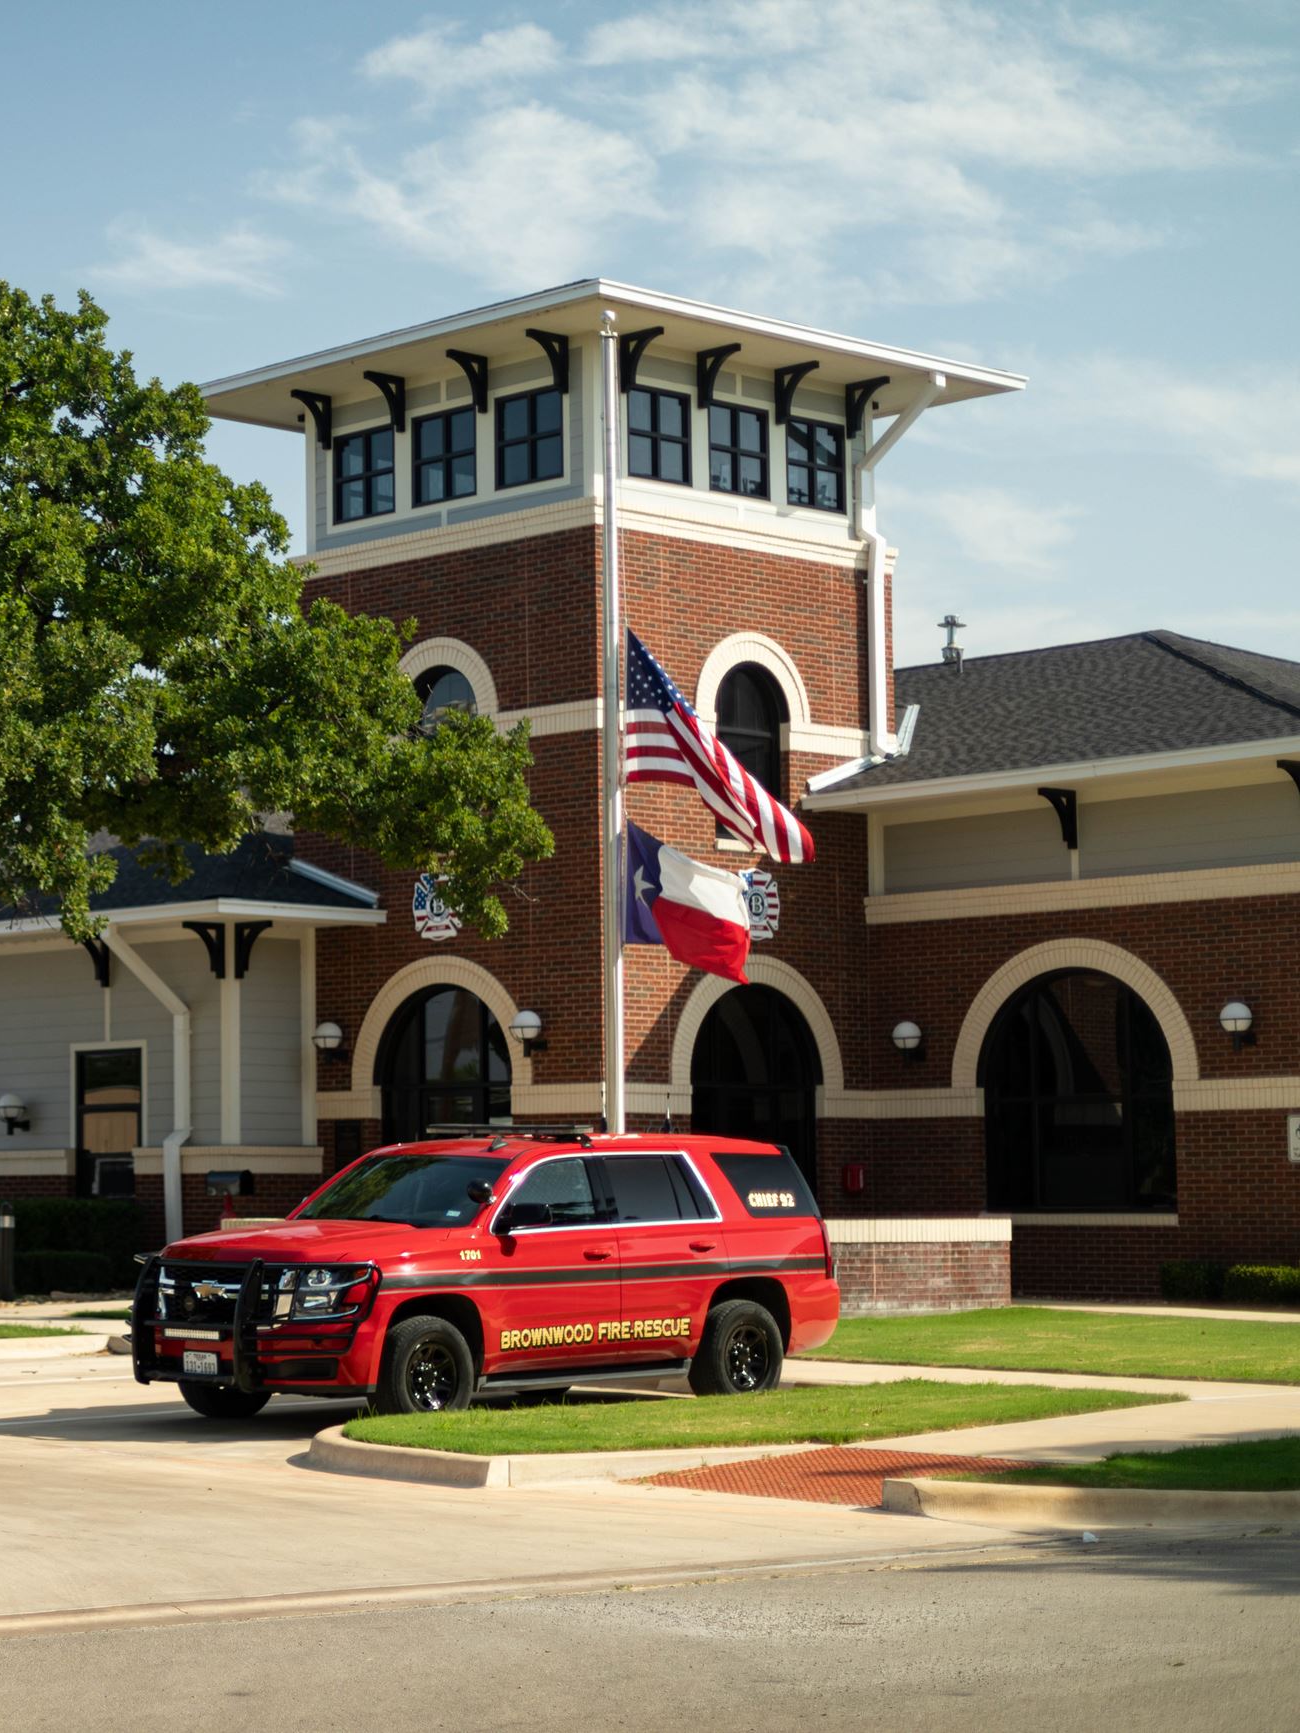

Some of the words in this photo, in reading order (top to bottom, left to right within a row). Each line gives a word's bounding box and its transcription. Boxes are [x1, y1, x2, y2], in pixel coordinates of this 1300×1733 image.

[752, 895, 763, 913] B
[748, 1192, 778, 1207] CHIEF
[780, 1192, 795, 1207] 92
[460, 1249, 481, 1260] 1701
[501, 1323, 594, 1350] BROWNWOOD
[598, 1317, 691, 1341] FIRE-RESCUE
